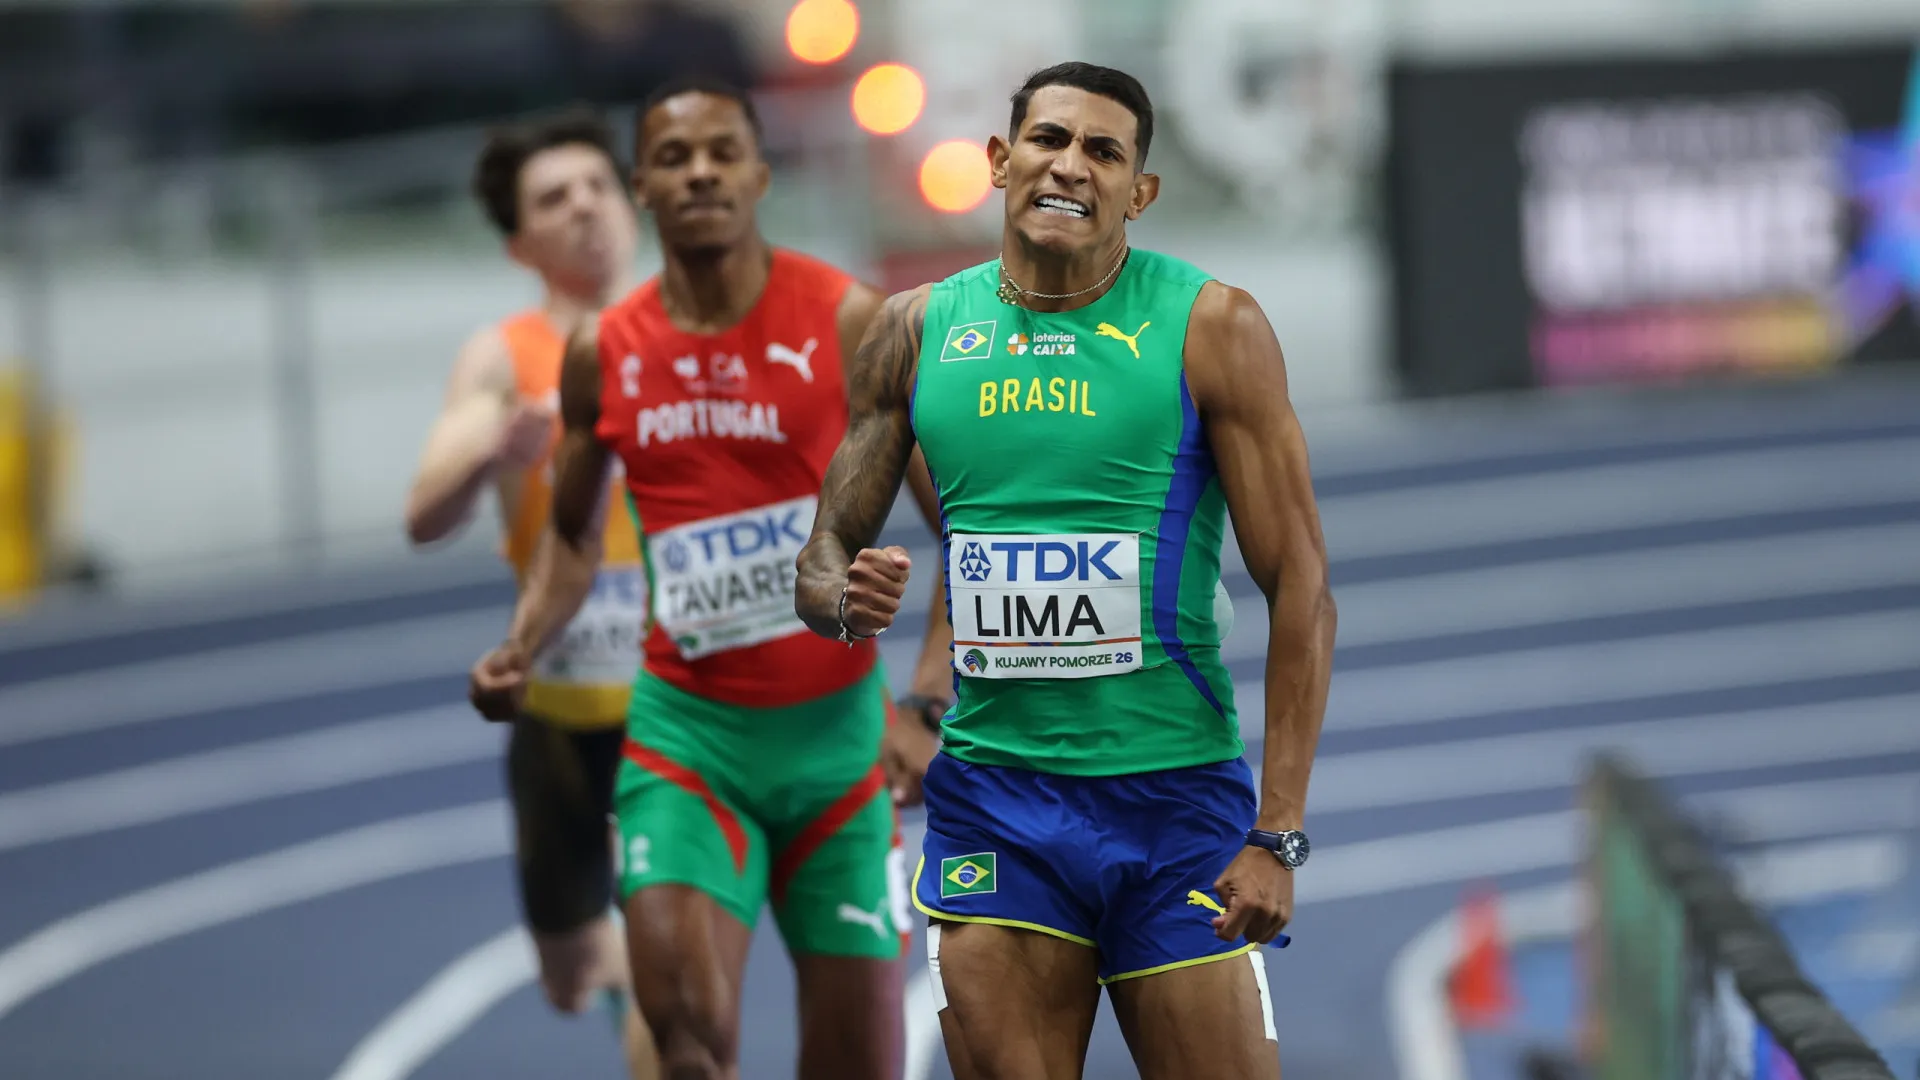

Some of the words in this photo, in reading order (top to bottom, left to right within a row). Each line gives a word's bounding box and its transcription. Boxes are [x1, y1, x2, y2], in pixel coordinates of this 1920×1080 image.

[1033, 333, 1075, 343] loterias
[1033, 344, 1075, 355] CAIXA
[979, 377, 1096, 417] BRASIL
[637, 400, 787, 448] PORTUGAL
[690, 508, 805, 562] TDK
[991, 541, 1123, 582] TDK
[667, 557, 795, 620] TAVARE
[975, 594, 1105, 637] LIMA
[995, 656, 1047, 668] KUJAWY
[1050, 653, 1112, 668] POMORZE
[1115, 652, 1133, 664] 26
